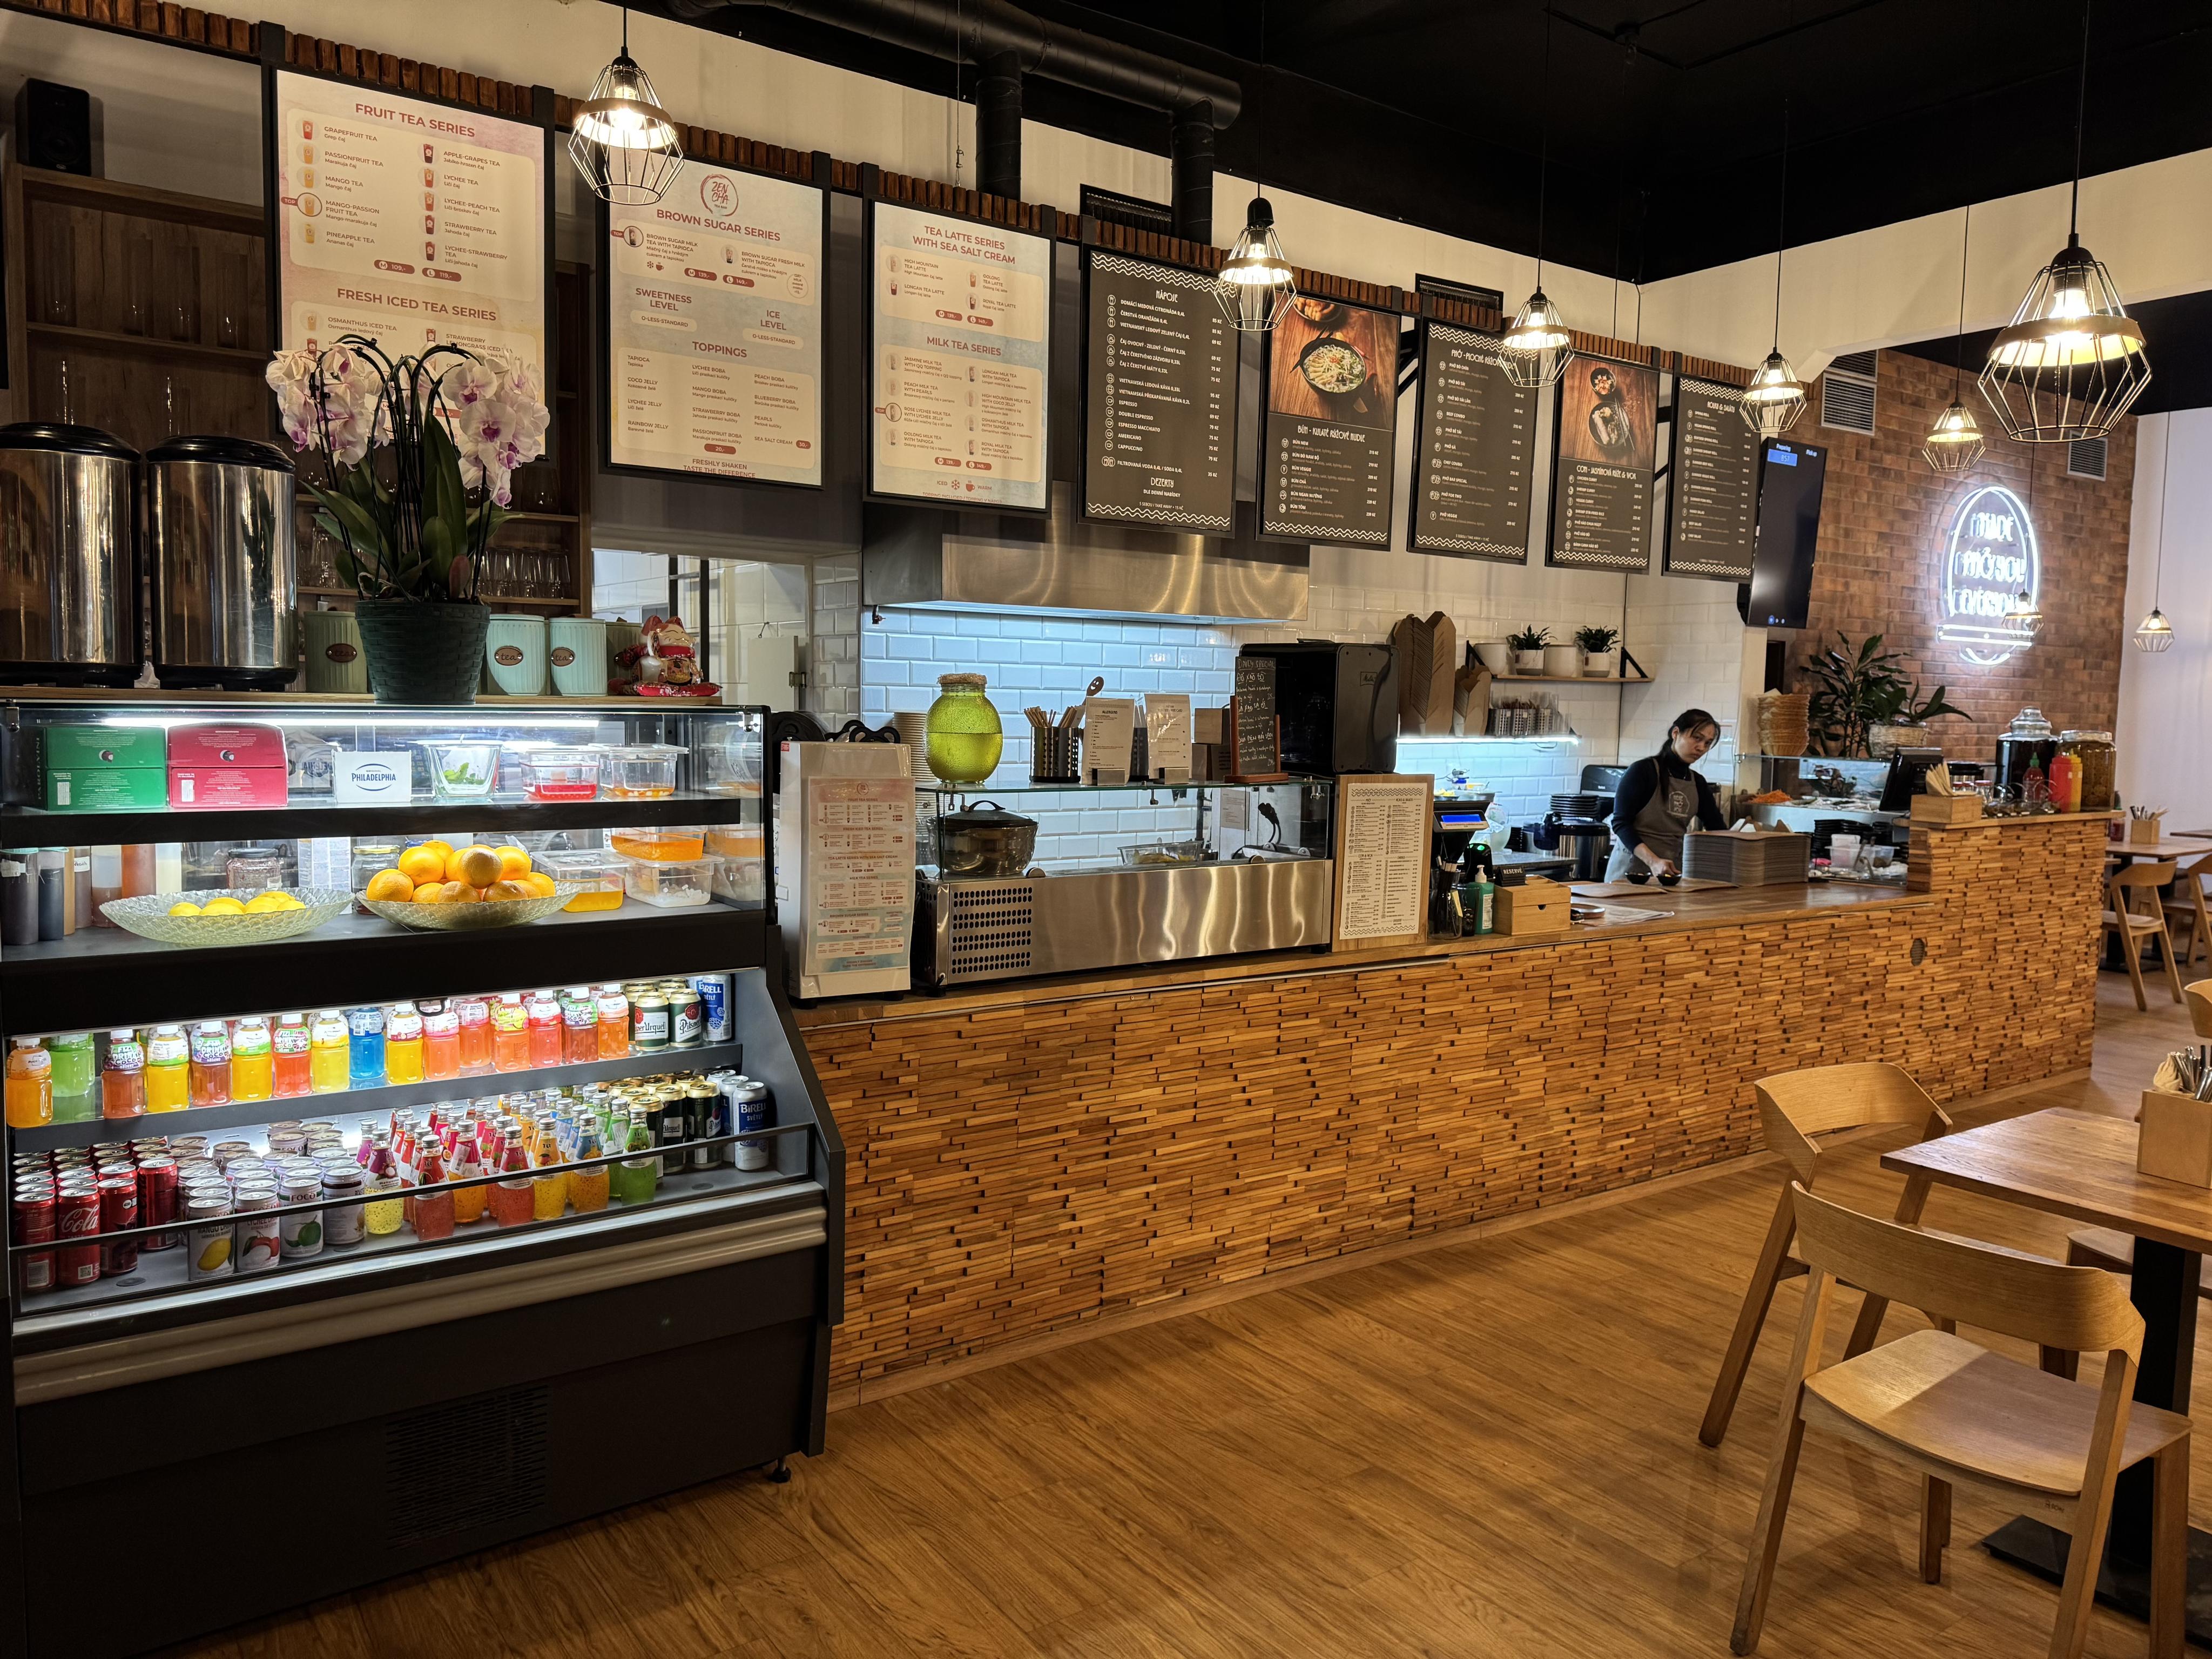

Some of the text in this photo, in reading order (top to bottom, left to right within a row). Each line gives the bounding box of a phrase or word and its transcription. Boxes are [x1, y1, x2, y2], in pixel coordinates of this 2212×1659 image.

[355, 103, 475, 137] FRUIT TEA SERIES
[324, 126, 363, 139] GRAPEFRUIT
[324, 133, 336, 141] Grep
[325, 151, 370, 166] PASSIONFRUIT
[444, 151, 488, 165] APPLE-GRAPES
[326, 176, 350, 185] MANGO
[444, 174, 465, 184] LYCHEE
[326, 183, 343, 191] Mango
[712, 181, 729, 193] ZEN
[712, 192, 730, 204] CHA
[326, 200, 380, 214] MANGO-PASSION
[444, 198, 487, 211] LYCHEE-PEACH
[326, 207, 343, 215] FRUIT
[444, 221, 484, 234] STRAWBERRY
[657, 209, 780, 241] BROWN SUGAR SERIES
[326, 231, 361, 242] PINEAPPLE
[925, 226, 1005, 250] TEA LATTE SERIES
[445, 245, 508, 260] LYCHEE-STRAWBERRY
[913, 235, 1015, 265] WITH SEA SALT CREAM
[636, 288, 692, 304] SWEETNESS
[1156, 289, 1178, 302] NÁPOJE
[337, 288, 496, 321] FRESH ICED TEA SERIES
[650, 300, 678, 312] LEVEL
[766, 310, 780, 319] ICE
[1121, 310, 1159, 322] ČERSTVÁ ORANŽÁDA
[1155, 307, 1177, 315] CITRONÁDA
[328, 317, 368, 327] OSMANTHUS
[760, 320, 786, 331] LEVEL
[1121, 322, 1145, 331] VIETNAMSKÝ
[446, 334, 485, 343] STRAWBERRY
[692, 341, 747, 358] TOPPINGS
[927, 336, 1001, 356] MILK TEA SERIES
[754, 394, 781, 403] BLUEBERRY
[692, 407, 725, 416] STRAWBERRY
[628, 420, 653, 428] RAINBOW
[692, 428, 727, 437] PASSIONFRUIT
[1298, 424, 1365, 442] BÚN KULATÉ RÝŽOVÉ NUDLE
[692, 459, 720, 467] FRESHLY
[718, 469, 756, 478] DIFFERENCE
[1151, 477, 1174, 488] DEZERTY
[501, 652, 516, 661] tea
[352, 773, 396, 782] PHILADELPHIA
[644, 1022, 666, 1034] Urquell
[291, 1193, 315, 1202] FOCO
[61, 1204, 99, 1233] Cola
